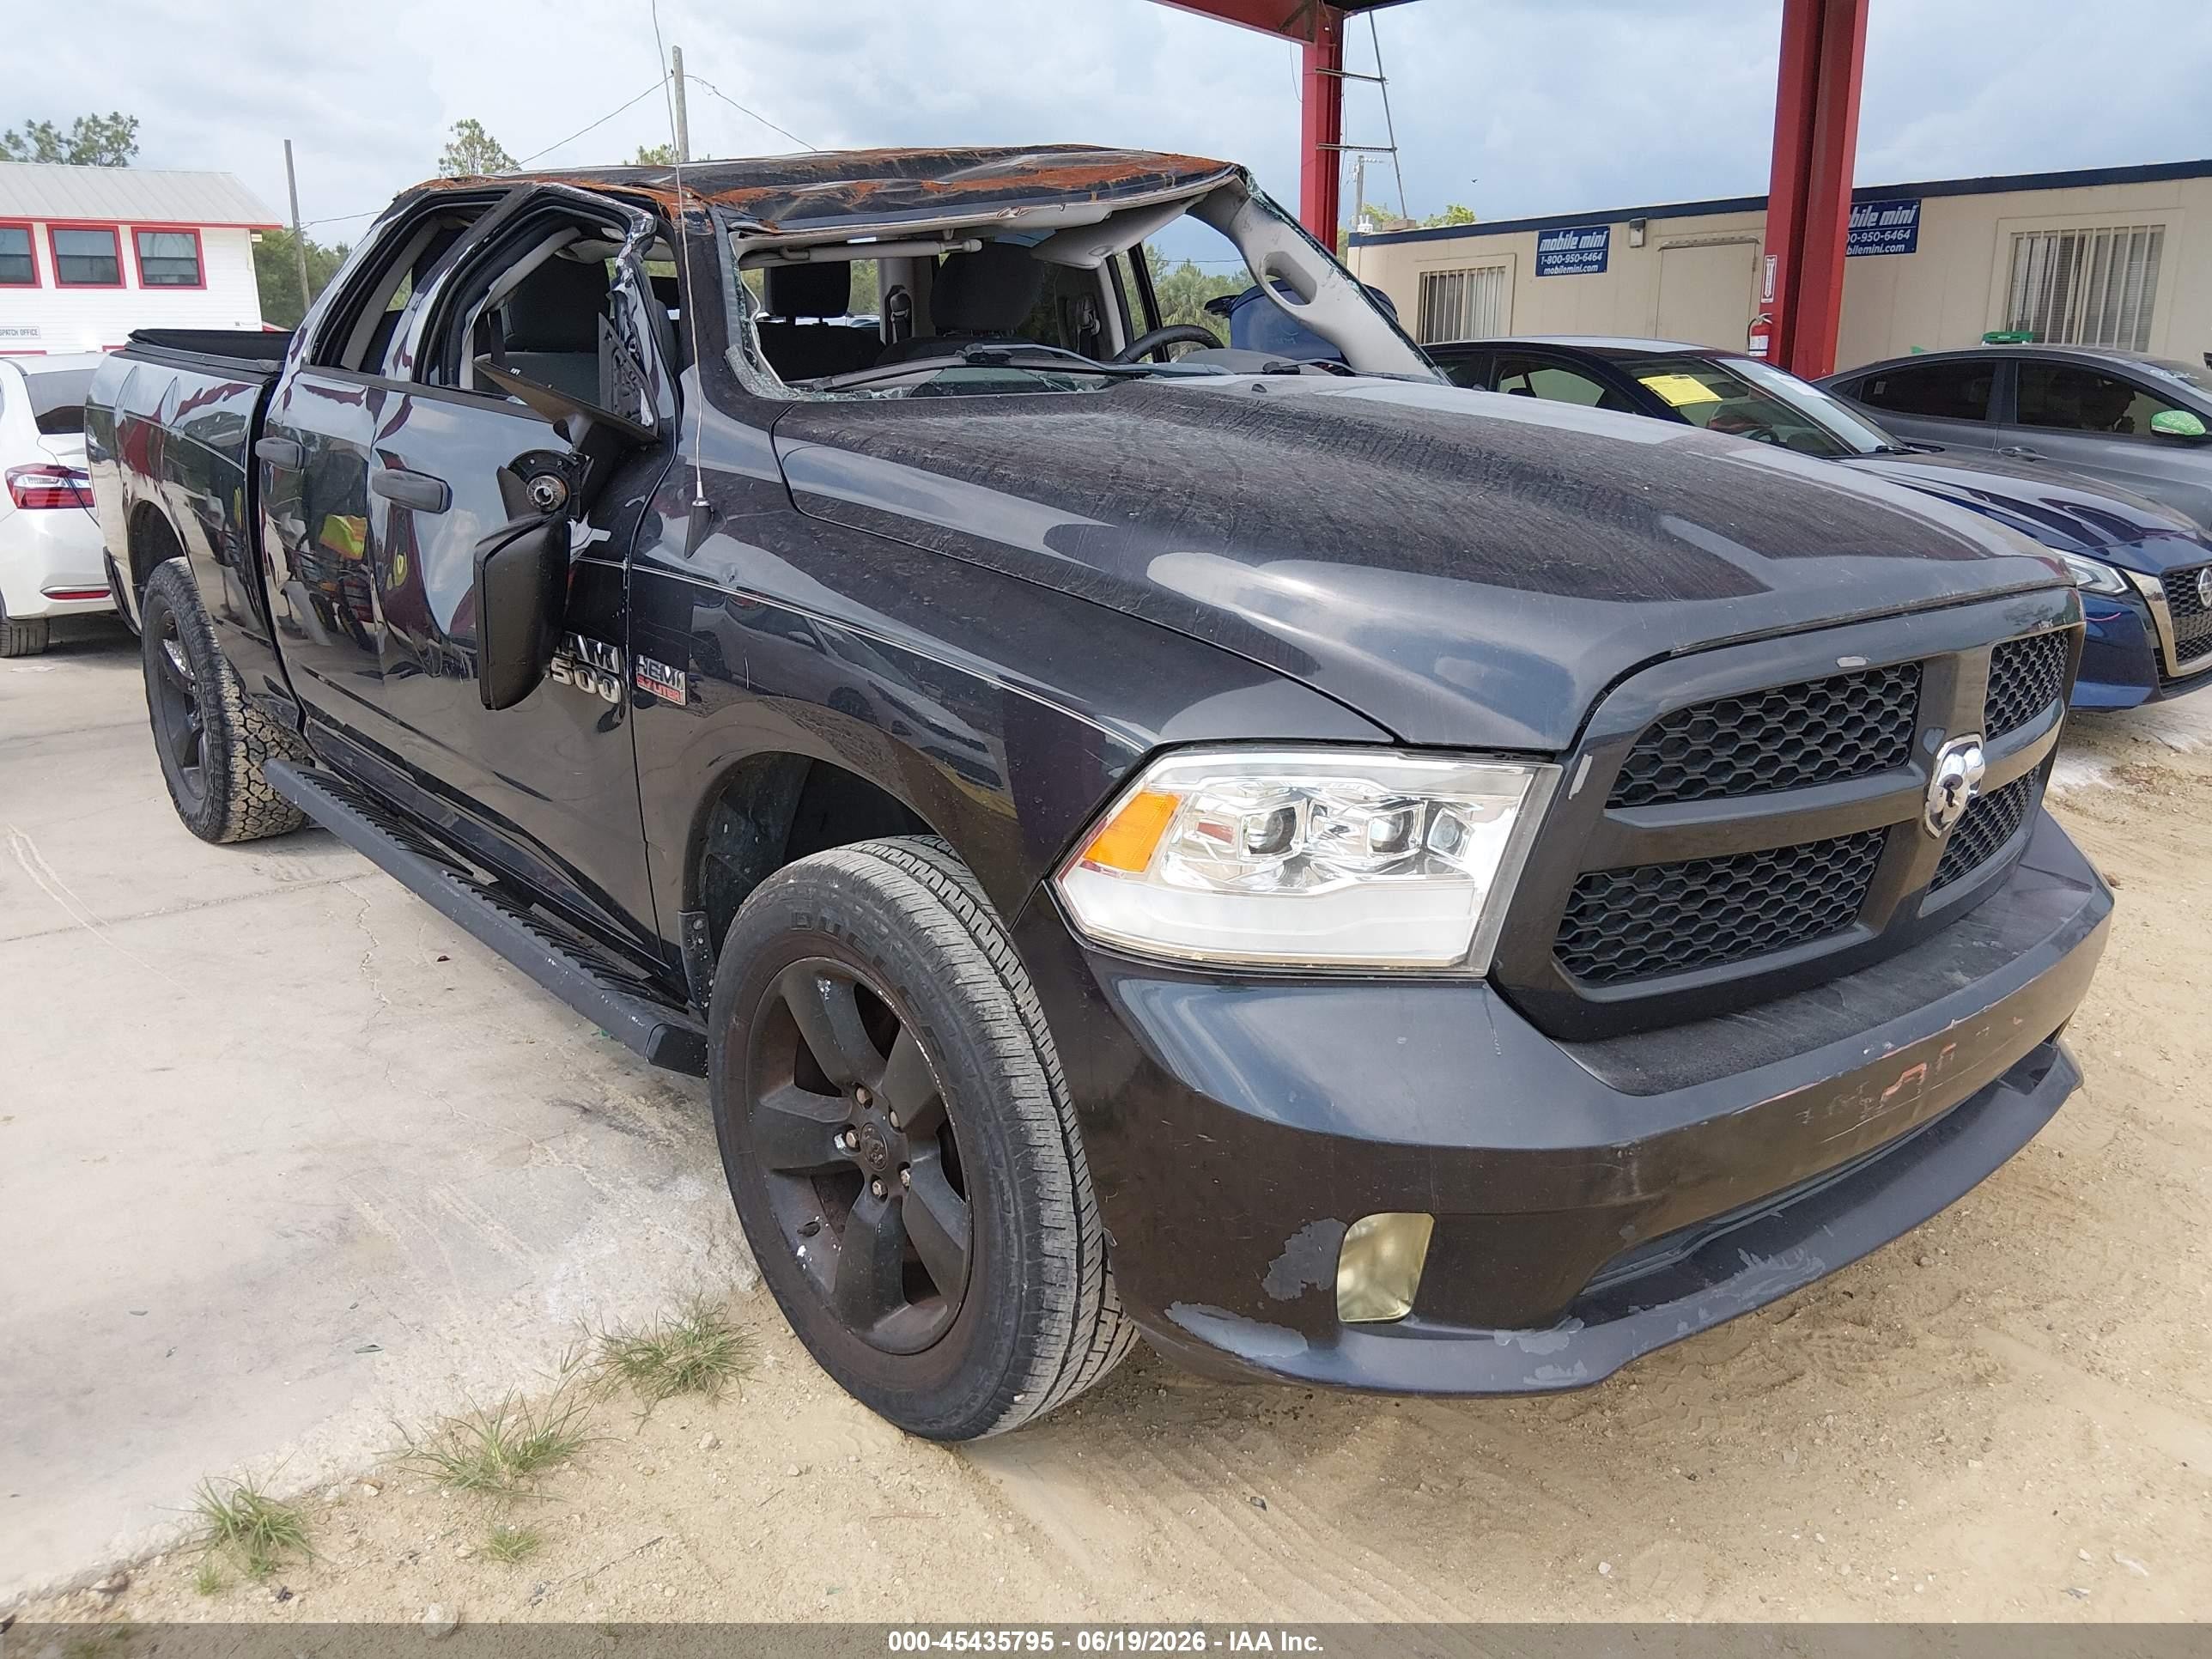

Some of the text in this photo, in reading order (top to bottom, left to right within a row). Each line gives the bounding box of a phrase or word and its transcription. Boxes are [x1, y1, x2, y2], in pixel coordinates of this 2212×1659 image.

[1879, 205, 1919, 226] mini
[1539, 230, 1609, 252] mobile mini
[1540, 252, 1604, 265] 1-800-950-6464
[1543, 264, 1599, 276] mobilemini.com
[652, 680, 682, 702] LITER
